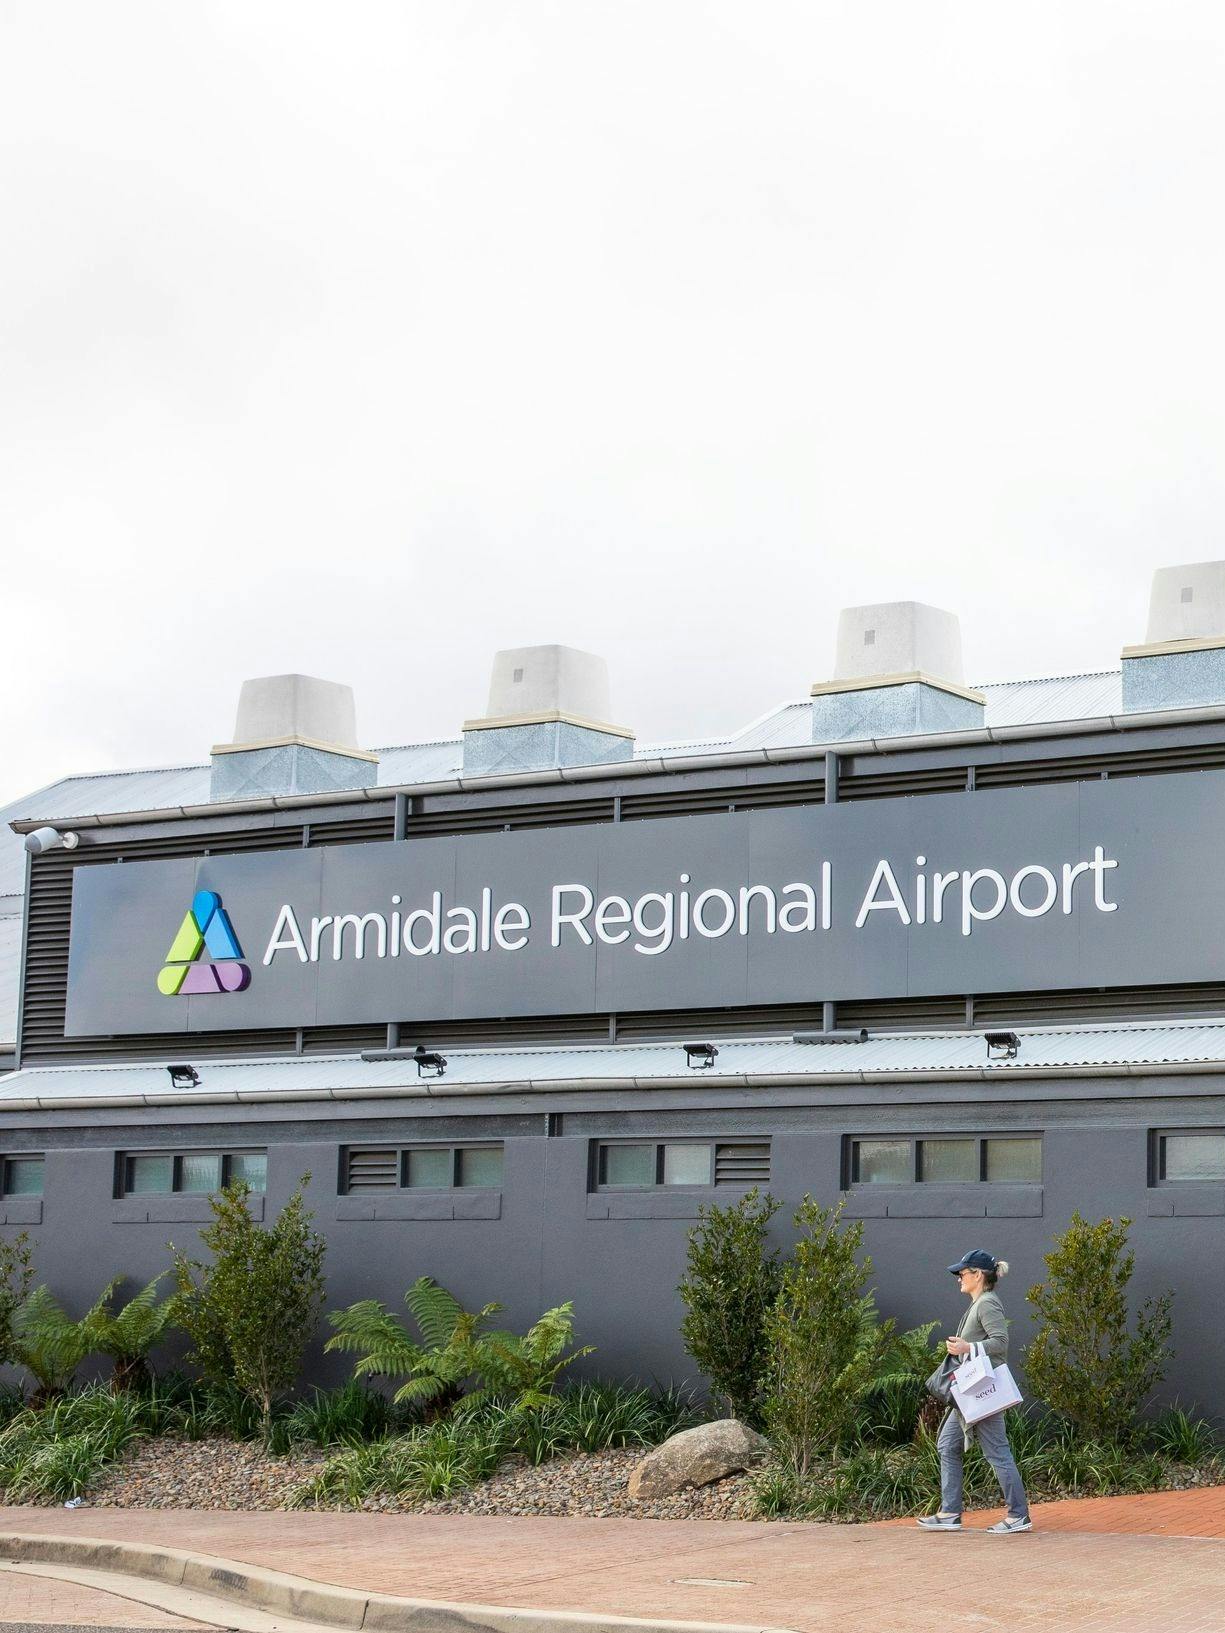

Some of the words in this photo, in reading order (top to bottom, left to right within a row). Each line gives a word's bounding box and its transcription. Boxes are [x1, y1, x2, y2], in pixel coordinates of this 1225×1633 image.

[263, 887, 530, 966] Armidale
[550, 860, 831, 956] Regional
[855, 846, 1118, 936] Airport
[975, 1384, 997, 1399] seed
